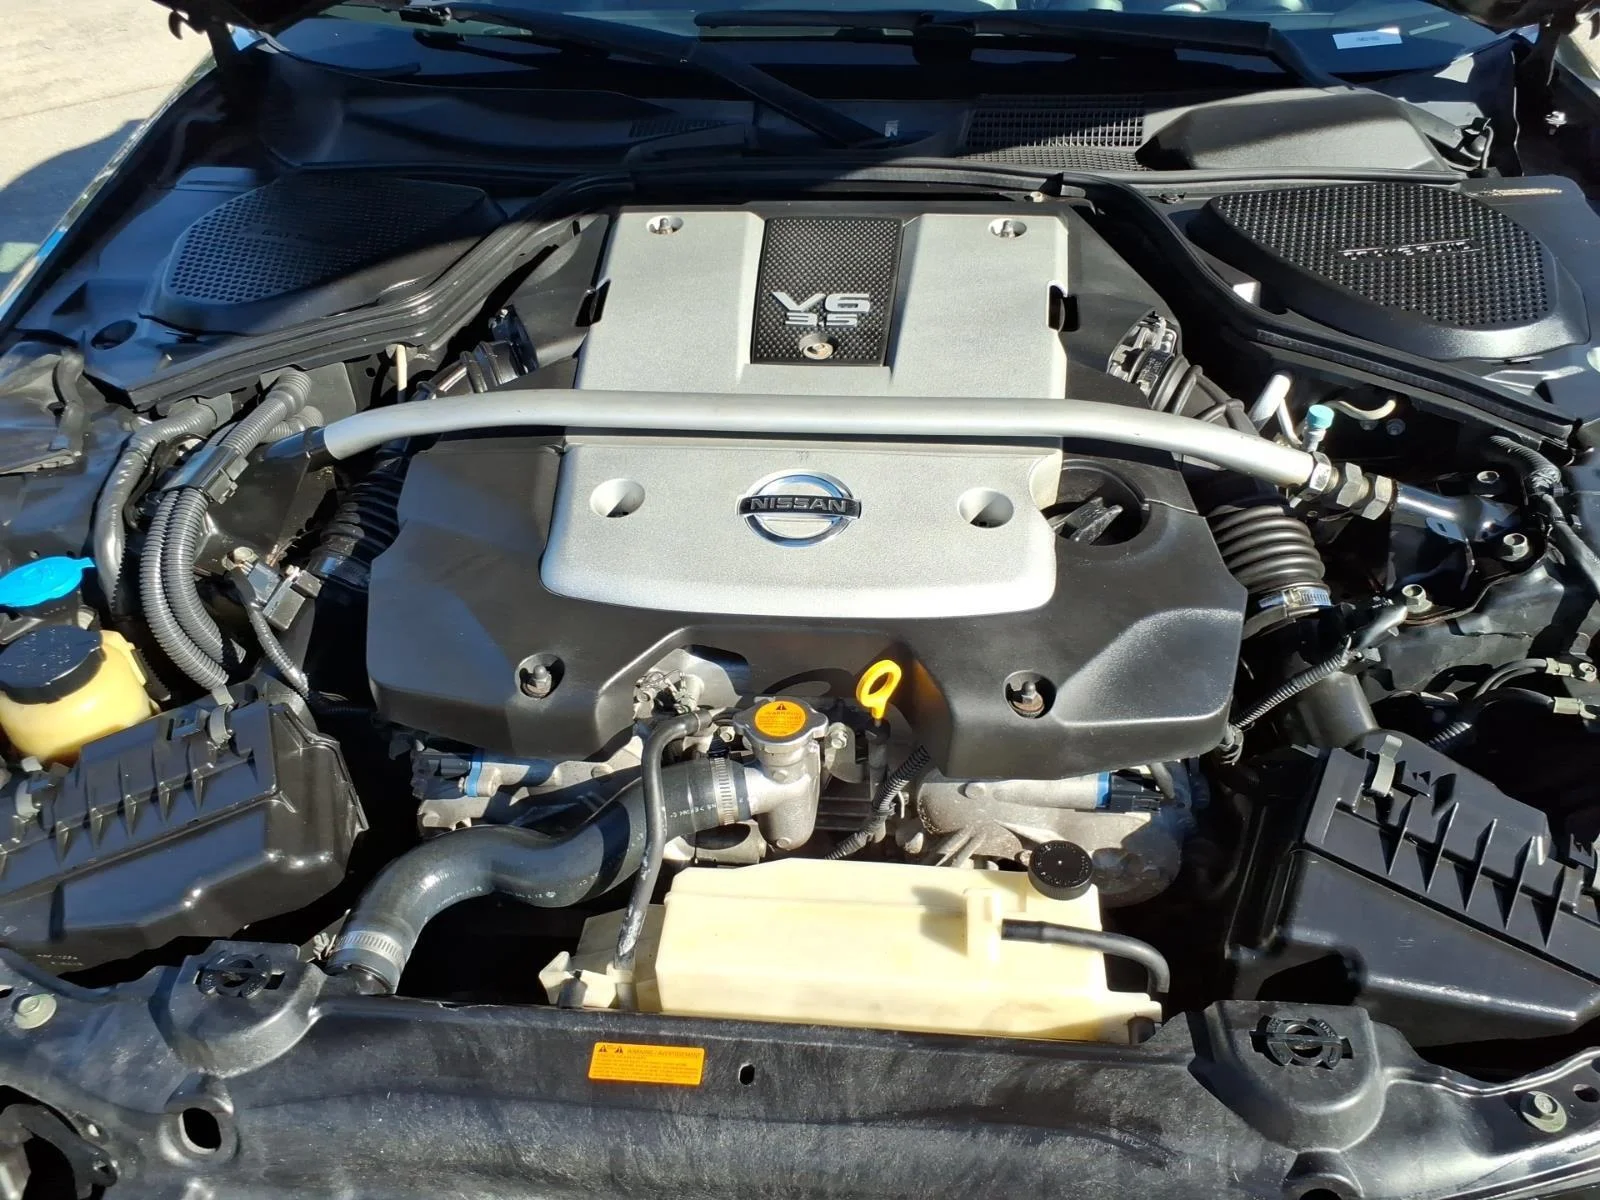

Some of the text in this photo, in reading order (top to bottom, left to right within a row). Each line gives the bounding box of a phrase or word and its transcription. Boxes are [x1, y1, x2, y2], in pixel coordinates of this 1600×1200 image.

[771, 291, 871, 313] V6
[784, 312, 859, 327] 3.5
[750, 497, 847, 513] NISSAN
